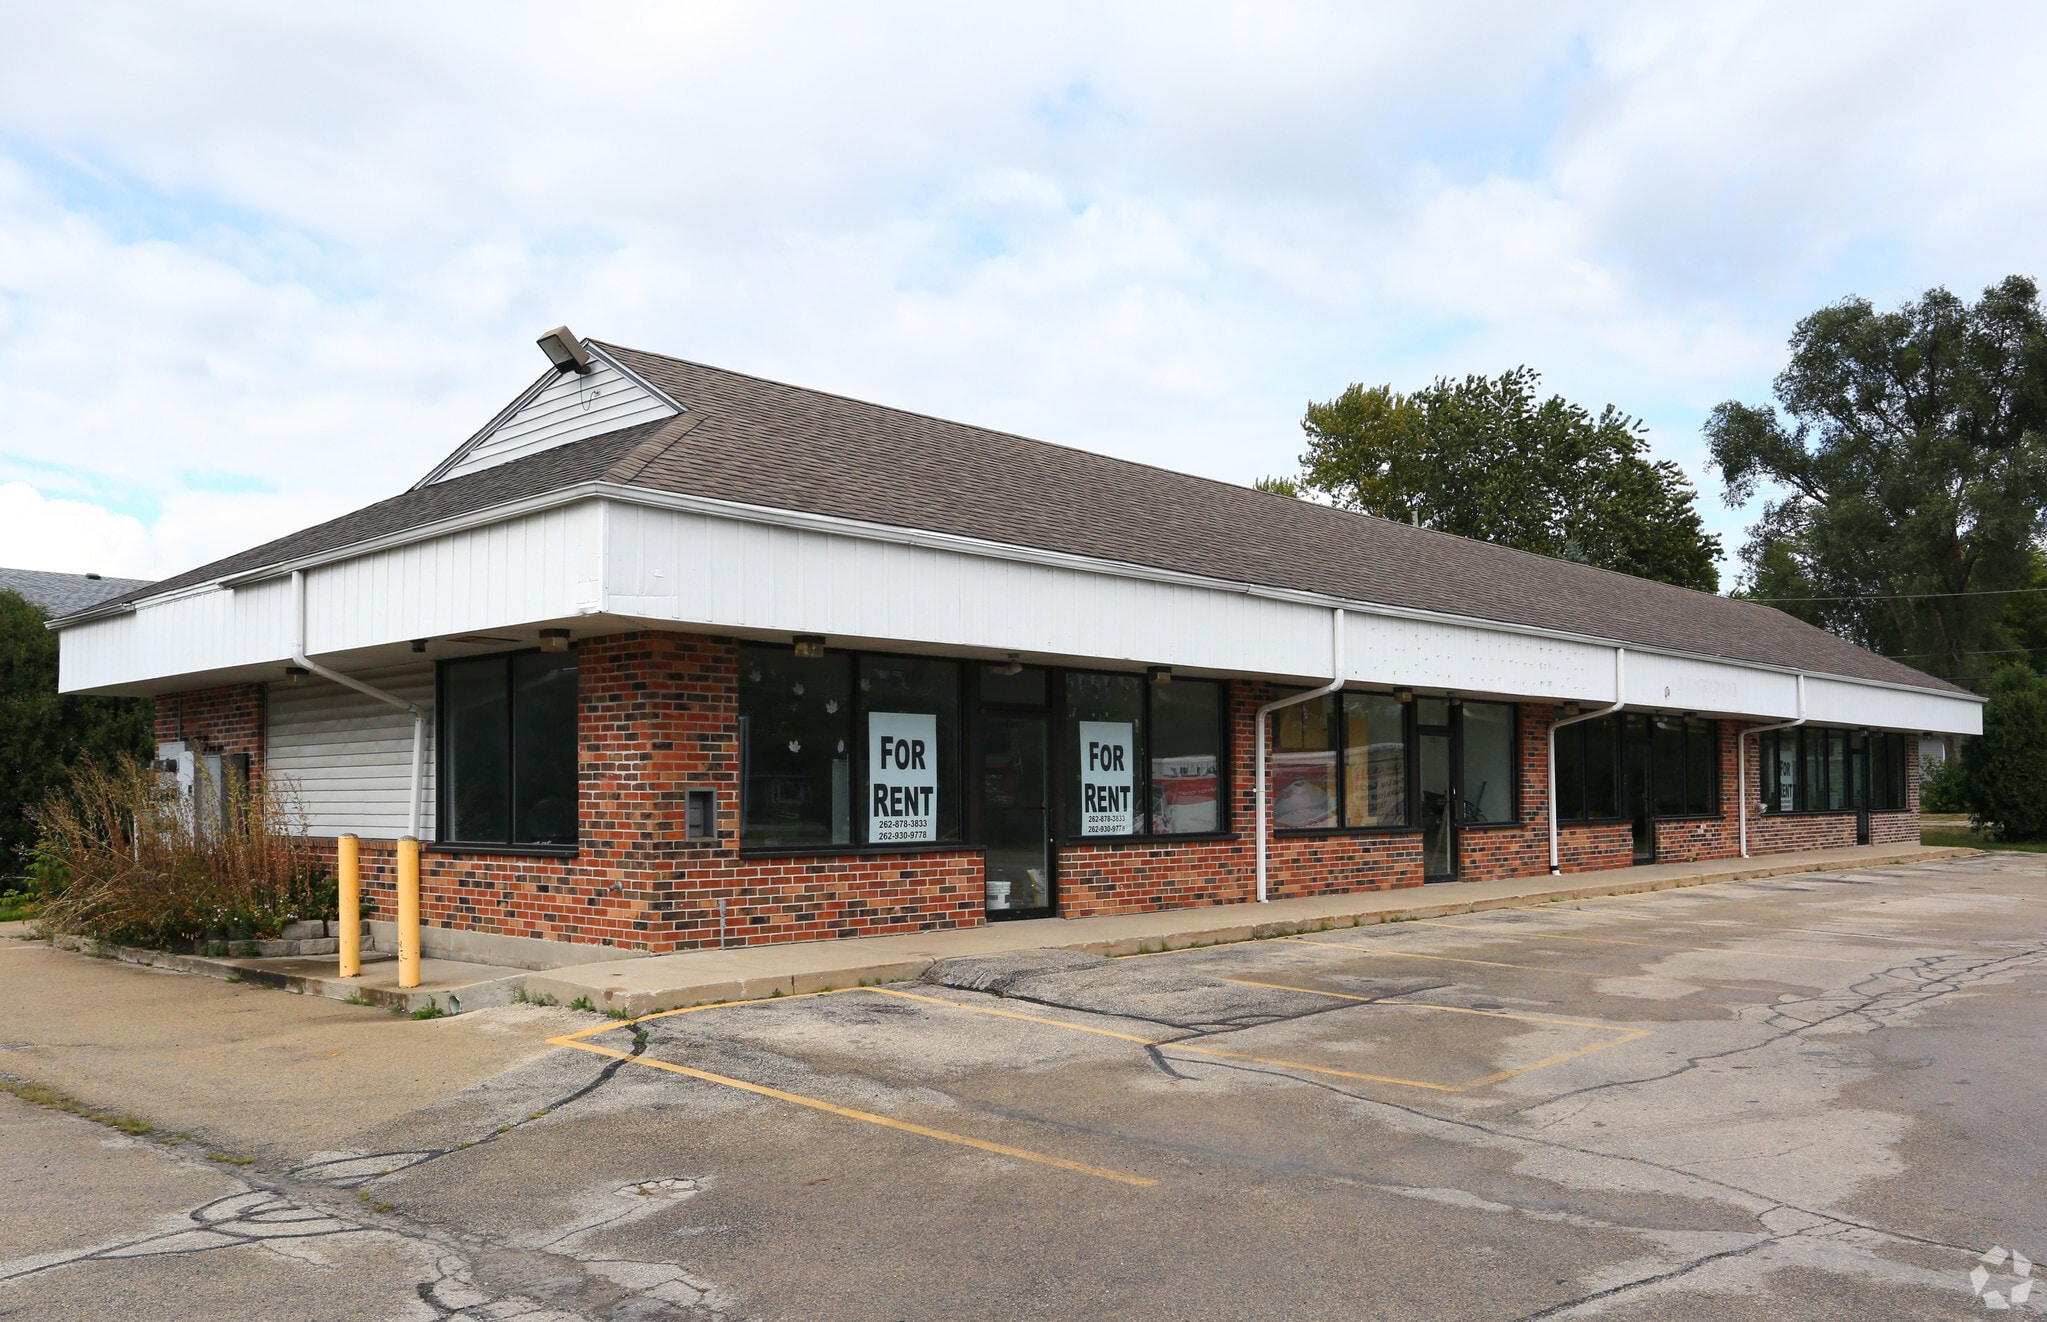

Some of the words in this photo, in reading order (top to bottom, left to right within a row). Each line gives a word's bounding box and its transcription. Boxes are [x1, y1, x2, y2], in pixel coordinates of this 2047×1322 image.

[881, 736, 926, 770] FOR
[1089, 742, 1125, 771] FOR
[1780, 761, 1791, 776] FOR
[873, 783, 934, 817] RENT
[1085, 783, 1131, 813] RENT
[879, 819, 928, 829] 262-878-3833
[1088, 815, 1126, 823] 262-878-3833
[879, 830, 928, 840] 262-930-9778
[1088, 825, 1126, 833] 262-930-9778
